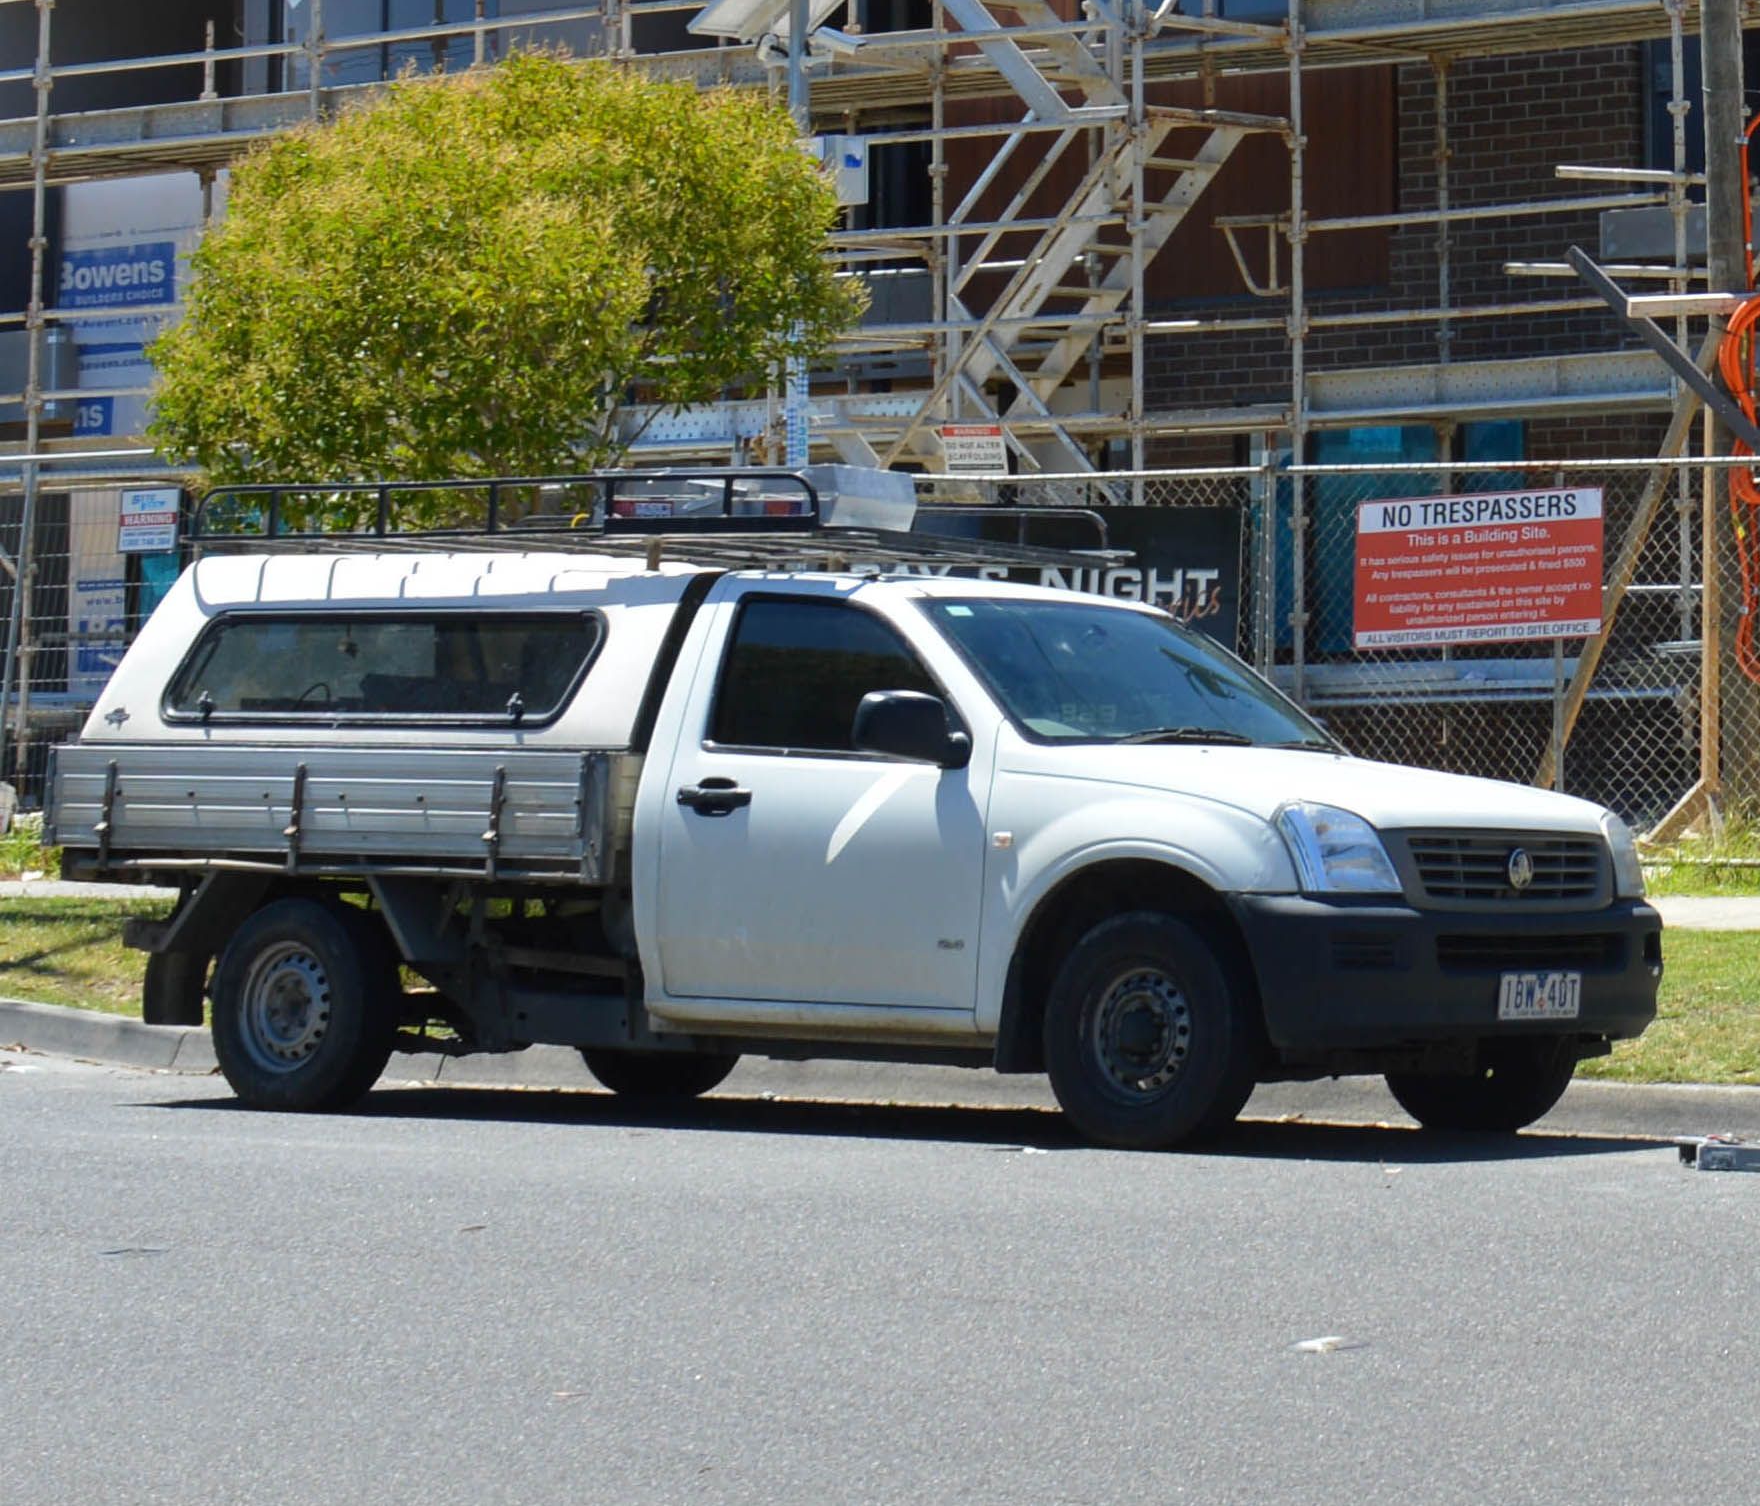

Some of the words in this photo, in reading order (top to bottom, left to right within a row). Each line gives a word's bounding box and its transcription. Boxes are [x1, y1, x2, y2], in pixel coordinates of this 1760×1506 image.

[60, 259, 166, 290] Bowens
[1382, 504, 1412, 528] NO
[1420, 493, 1577, 526] TRESPASSERS
[1407, 533, 1435, 547] This
[1438, 532, 1449, 545] is
[1452, 533, 1461, 544] a
[1464, 528, 1518, 543] Building
[1521, 525, 1551, 540] Site.
[1422, 553, 1449, 564] safety
[1481, 549, 1494, 559] for
[1371, 570, 1389, 581] Any
[1461, 564, 1474, 574] be
[1039, 566, 1219, 607] NIGHT
[1497, 585, 1513, 596] the
[1578, 581, 1592, 592] no
[1422, 601, 1436, 613] for
[1437, 601, 1455, 613] any
[1501, 598, 1514, 608] on
[1515, 596, 1533, 607] this
[1534, 595, 1552, 606] site
[1553, 595, 1566, 606] by
[1499, 608, 1538, 620] entering
[1366, 633, 1385, 644] ALL
[1386, 630, 1433, 643] VISITORS
[1434, 628, 1463, 641] MUST
[1467, 626, 1508, 639] REPORT
[1511, 625, 1524, 637] TO
[1527, 623, 1551, 636] SITE
[1552, 621, 1590, 634] OFFICE
